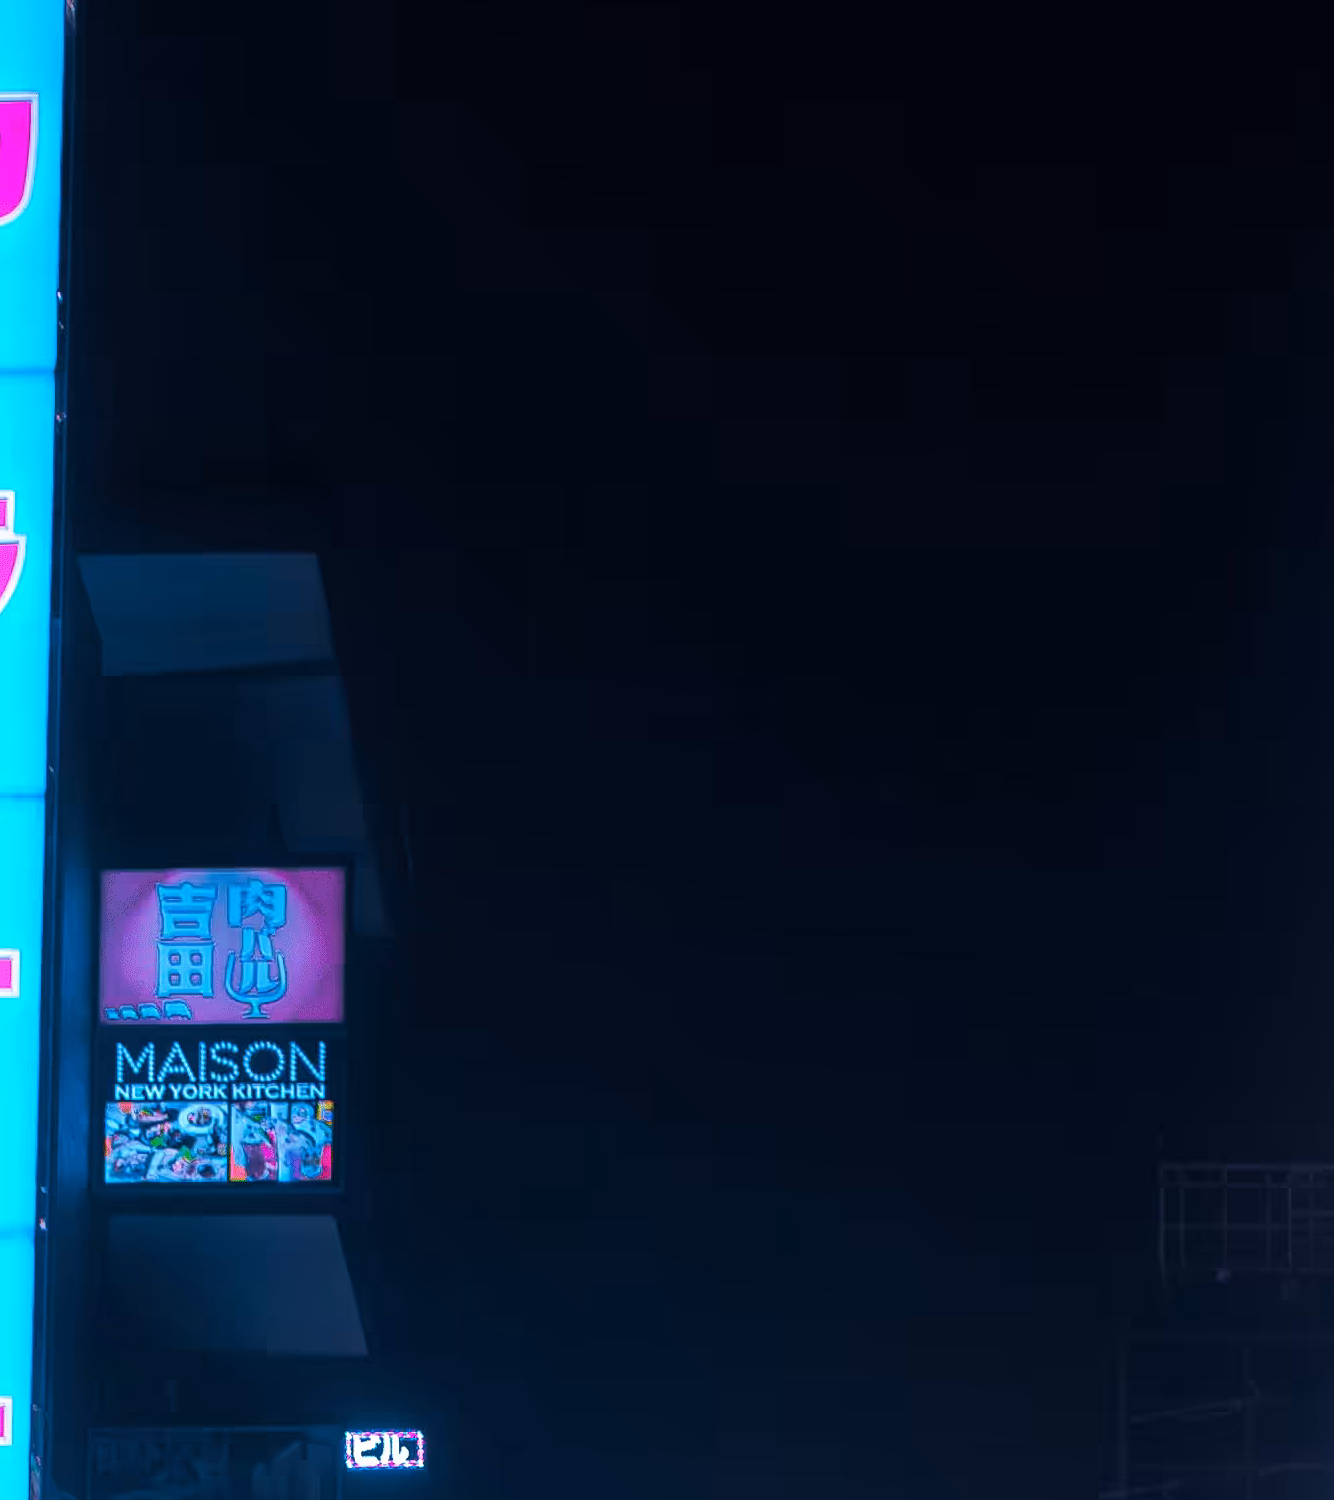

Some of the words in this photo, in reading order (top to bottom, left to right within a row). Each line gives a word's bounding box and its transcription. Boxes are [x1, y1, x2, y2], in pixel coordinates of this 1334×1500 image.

[115, 1041, 326, 1081] MAISON
[115, 1083, 166, 1100] NEW
[169, 1083, 228, 1100] YORK
[232, 1083, 325, 1100] KITCHEN
